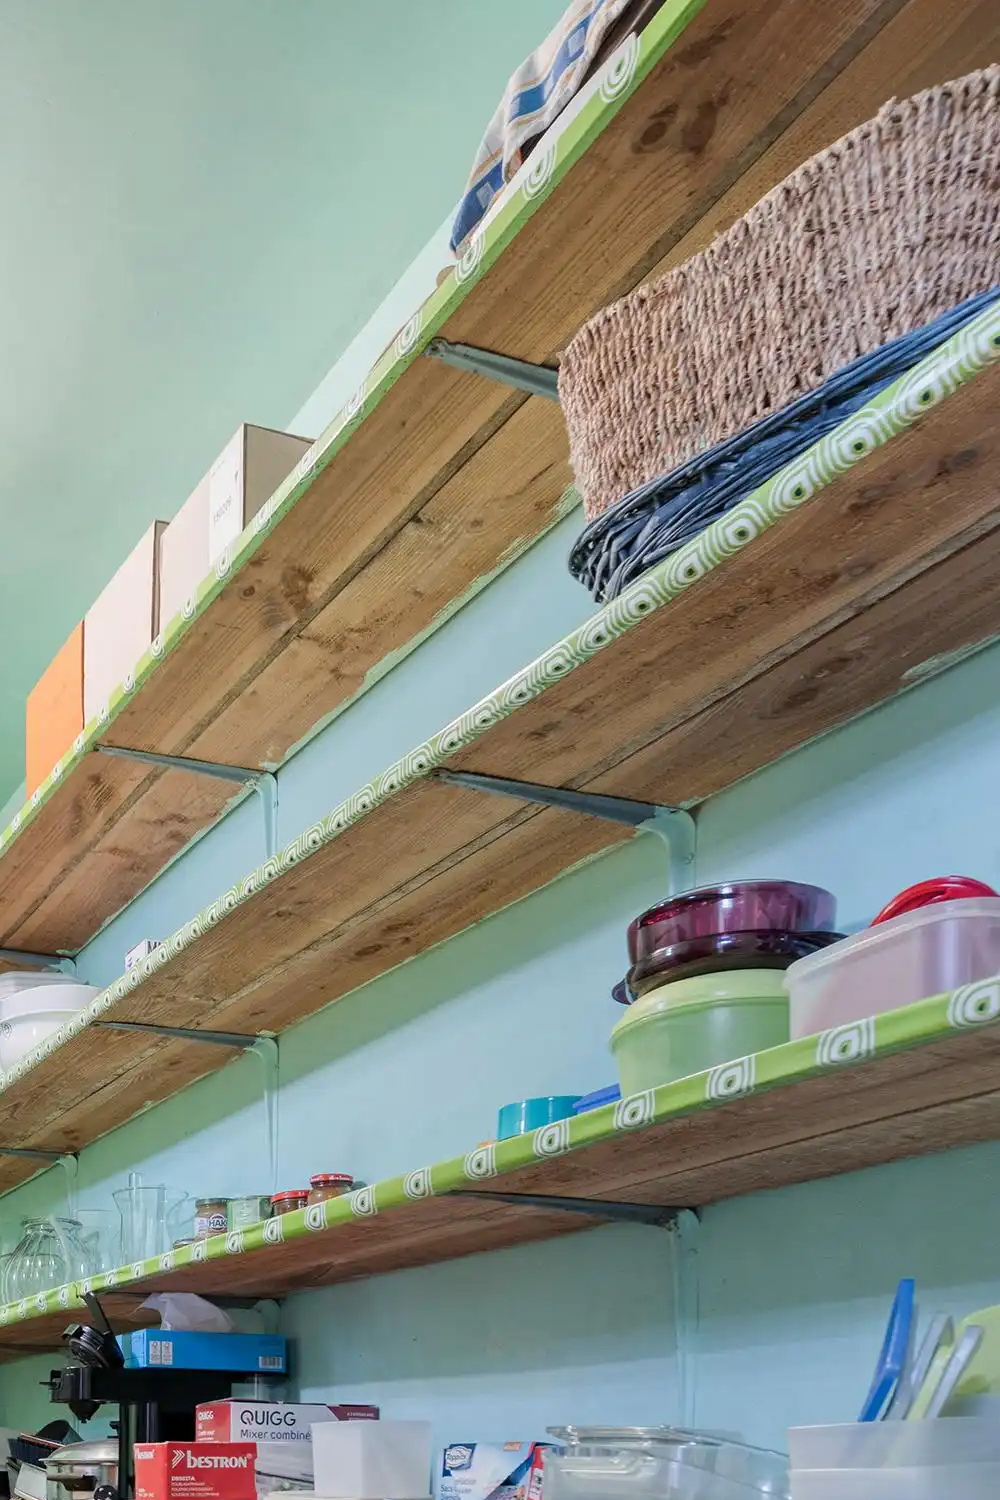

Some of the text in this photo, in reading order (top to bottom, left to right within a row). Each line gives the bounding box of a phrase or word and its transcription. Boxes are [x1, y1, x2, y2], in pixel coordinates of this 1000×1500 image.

[240, 1409, 297, 1426] QUIGG
[240, 1429, 312, 1441] Mixer combiné
